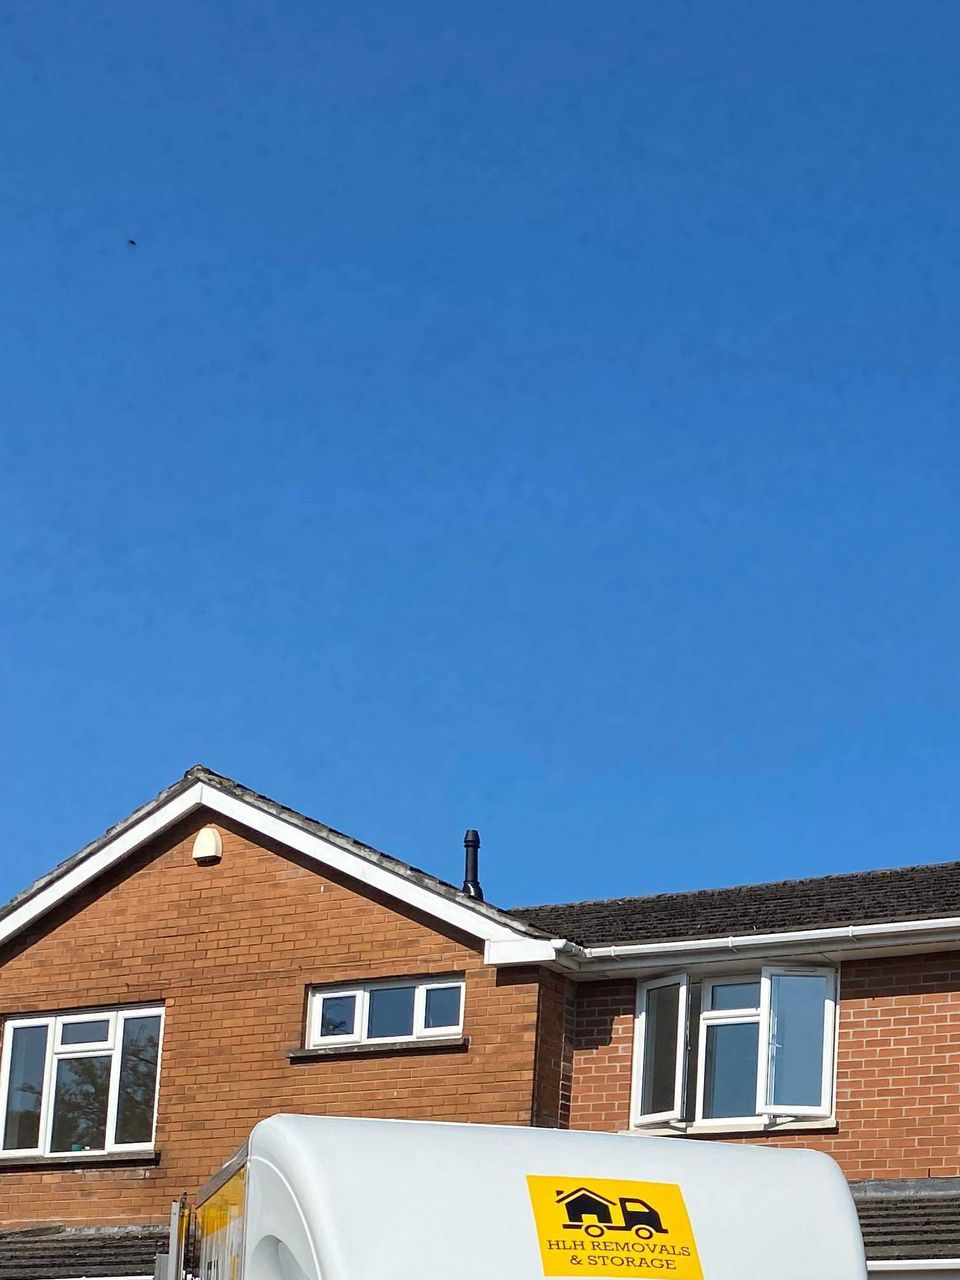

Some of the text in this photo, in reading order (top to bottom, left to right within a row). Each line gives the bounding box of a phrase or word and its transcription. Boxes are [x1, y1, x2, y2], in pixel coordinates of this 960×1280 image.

[548, 1240, 691, 1256] HLH REMOVALS
[570, 1255, 677, 1269] & STORAGE
